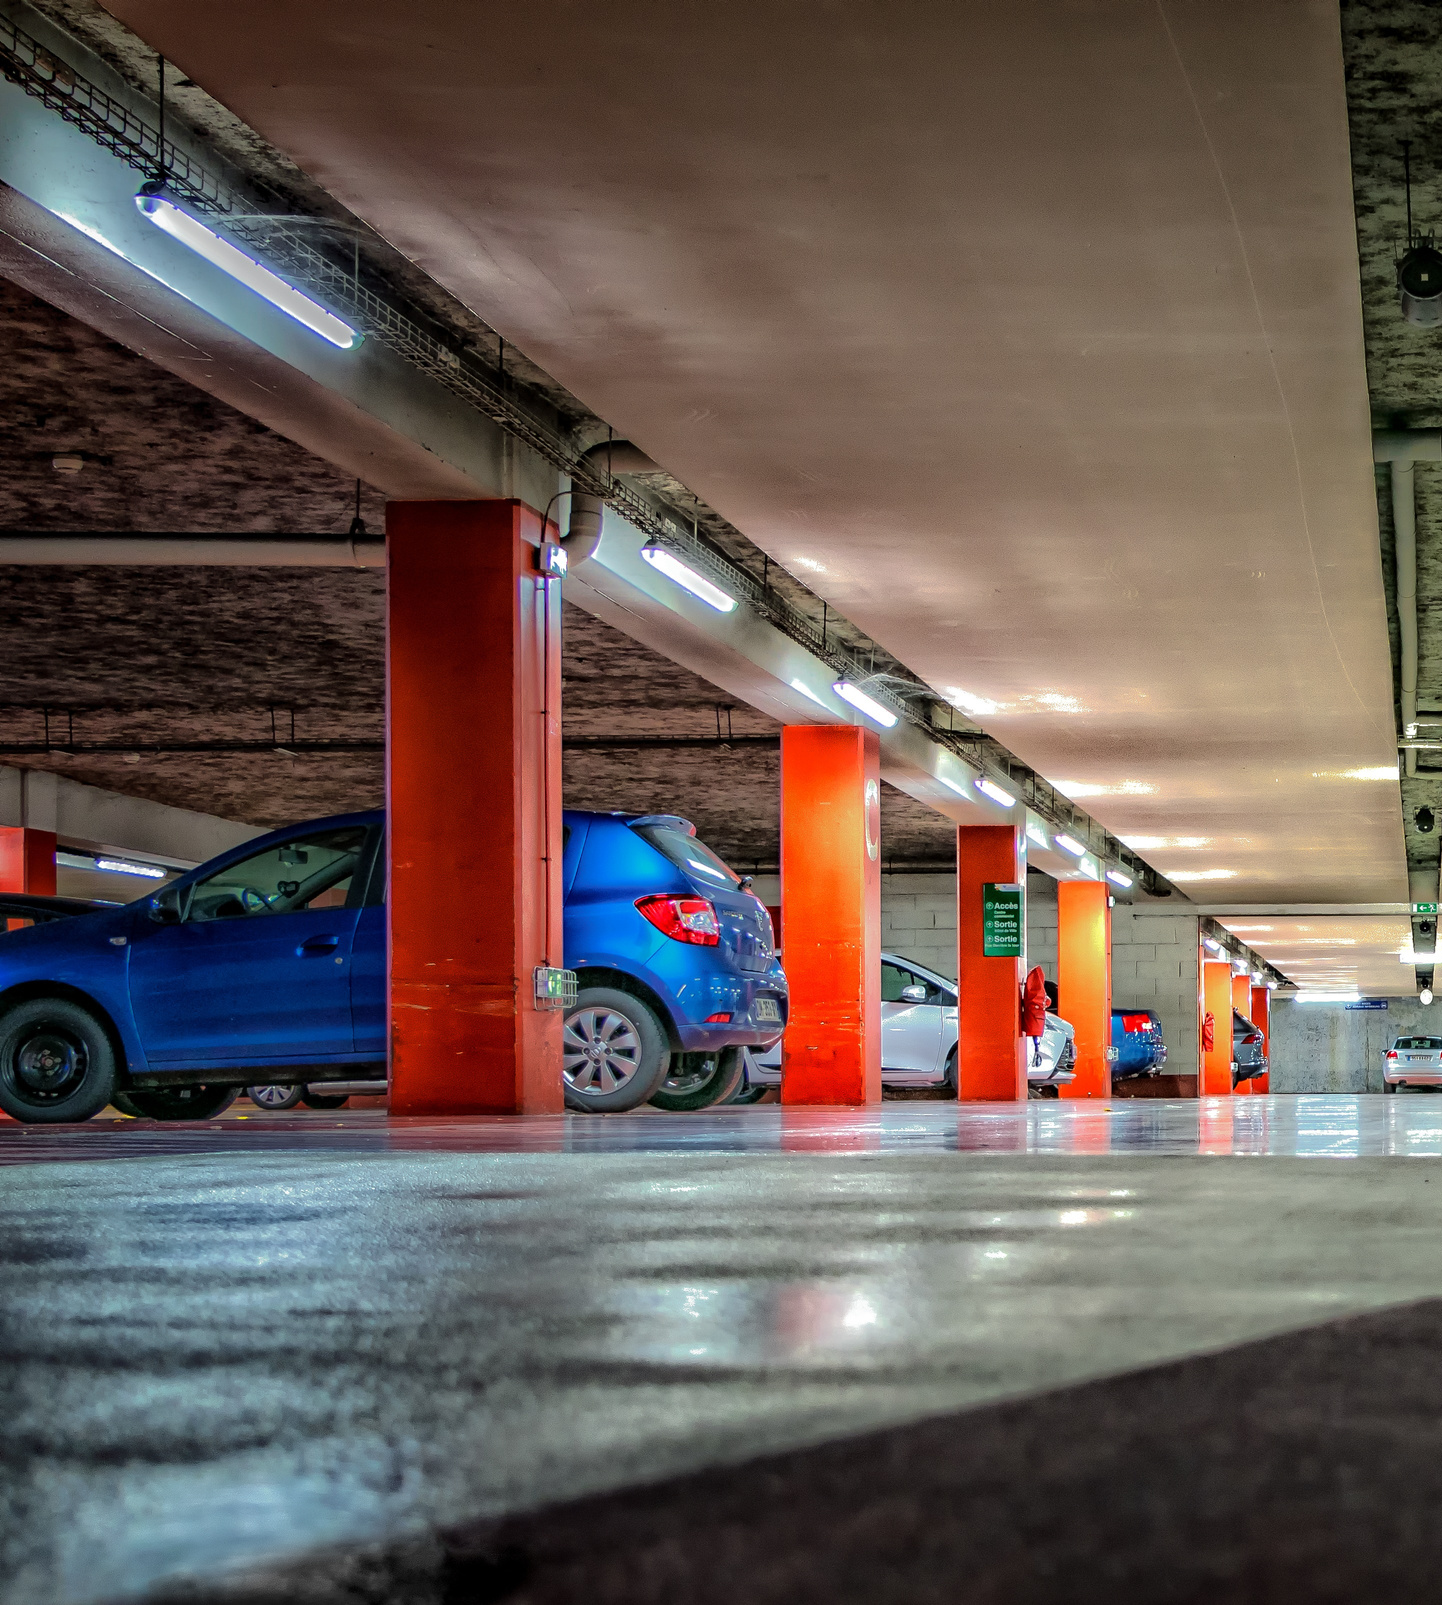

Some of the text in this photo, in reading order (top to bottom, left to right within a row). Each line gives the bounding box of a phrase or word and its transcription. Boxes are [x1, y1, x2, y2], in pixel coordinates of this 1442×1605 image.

[993, 901, 1019, 910] Accès
[994, 920, 1018, 928] Sortie
[994, 935, 1018, 943] Sortie
